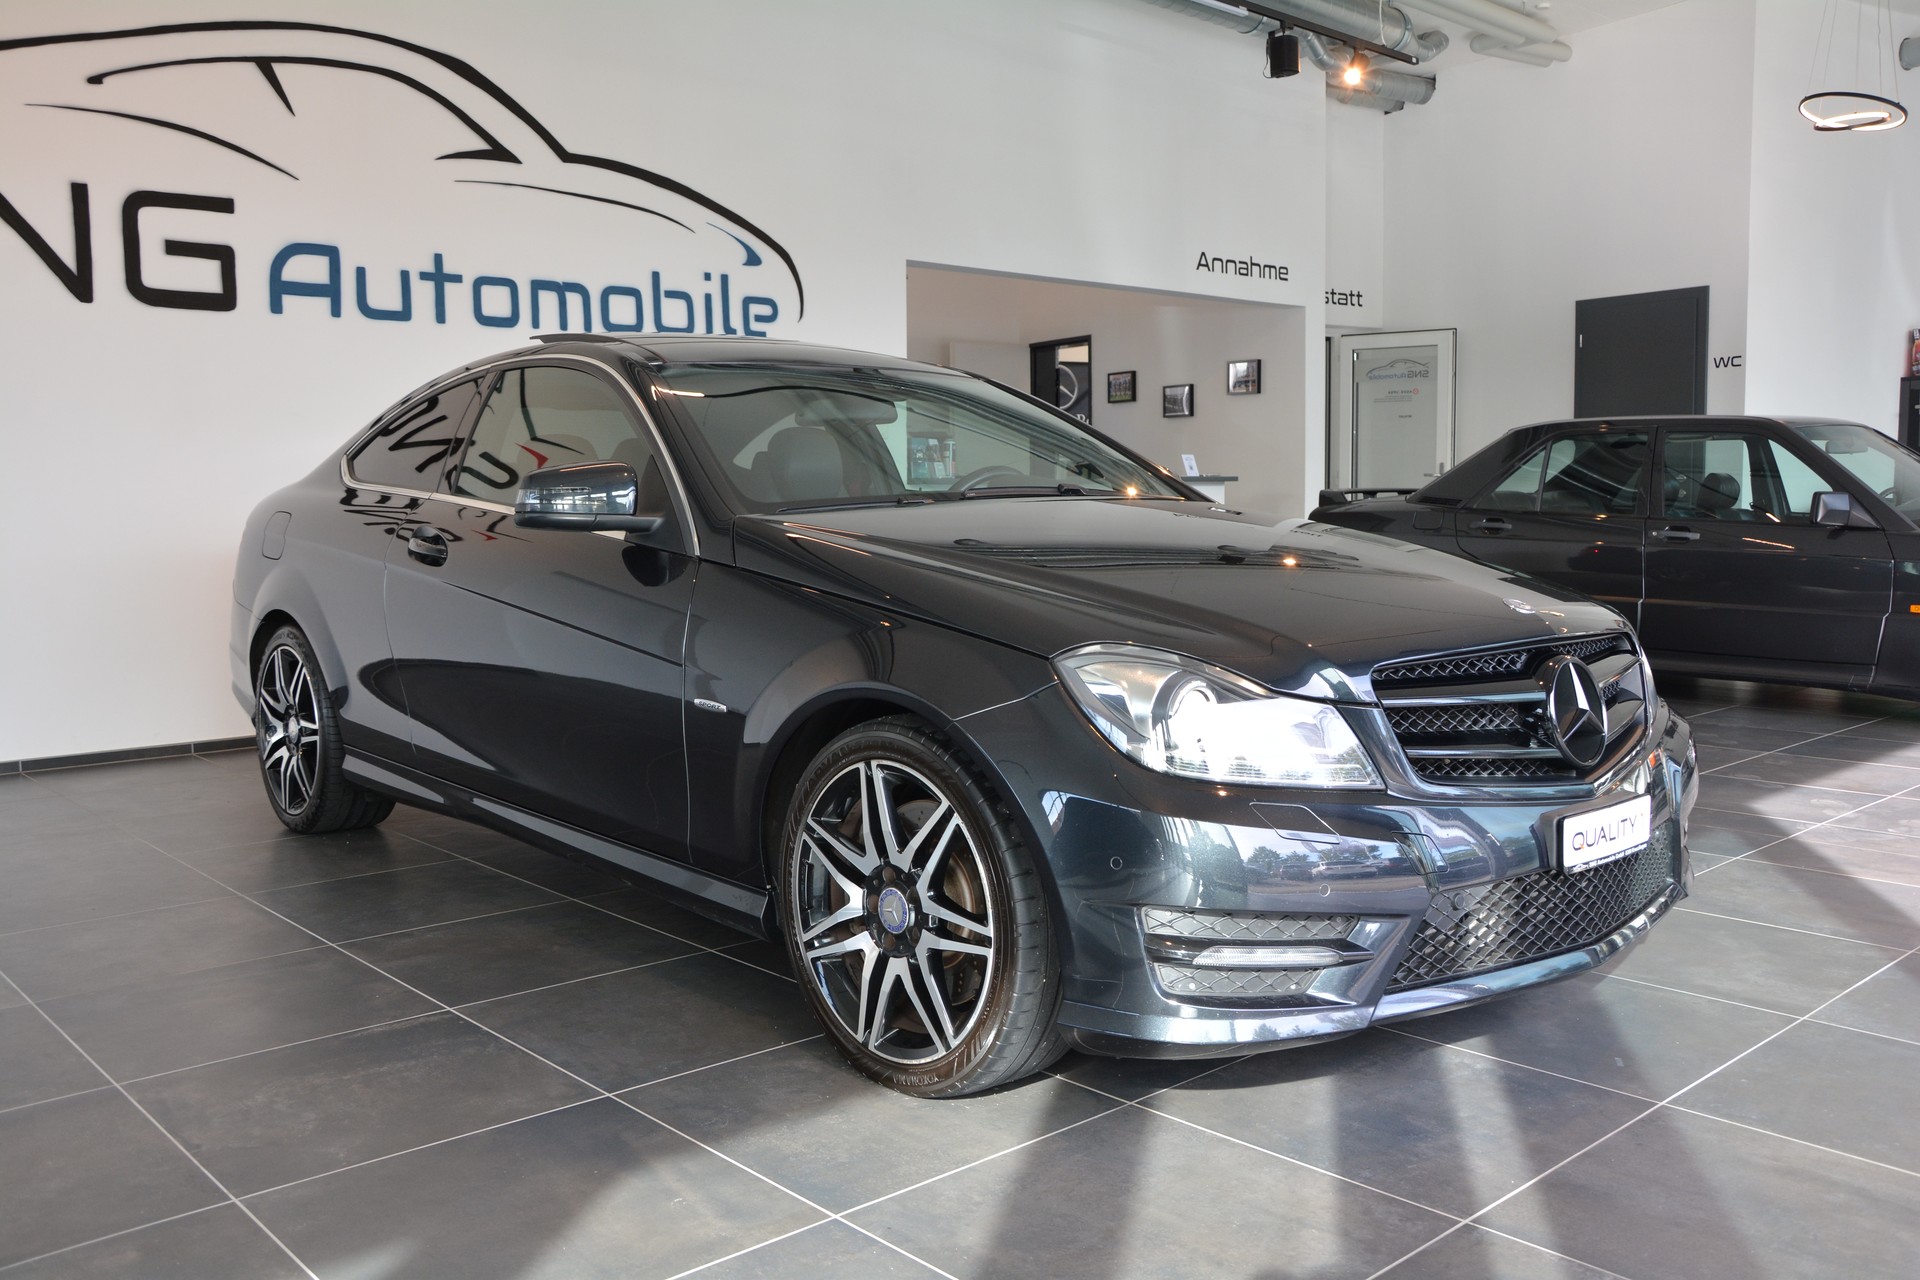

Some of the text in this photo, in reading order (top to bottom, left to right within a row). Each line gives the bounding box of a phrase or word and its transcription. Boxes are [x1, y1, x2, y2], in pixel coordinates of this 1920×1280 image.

[1196, 251, 1289, 281] Annahme
[268, 242, 779, 337] Automobile
[1713, 355, 1742, 368] WC
[1572, 816, 1636, 851] QUALITY
